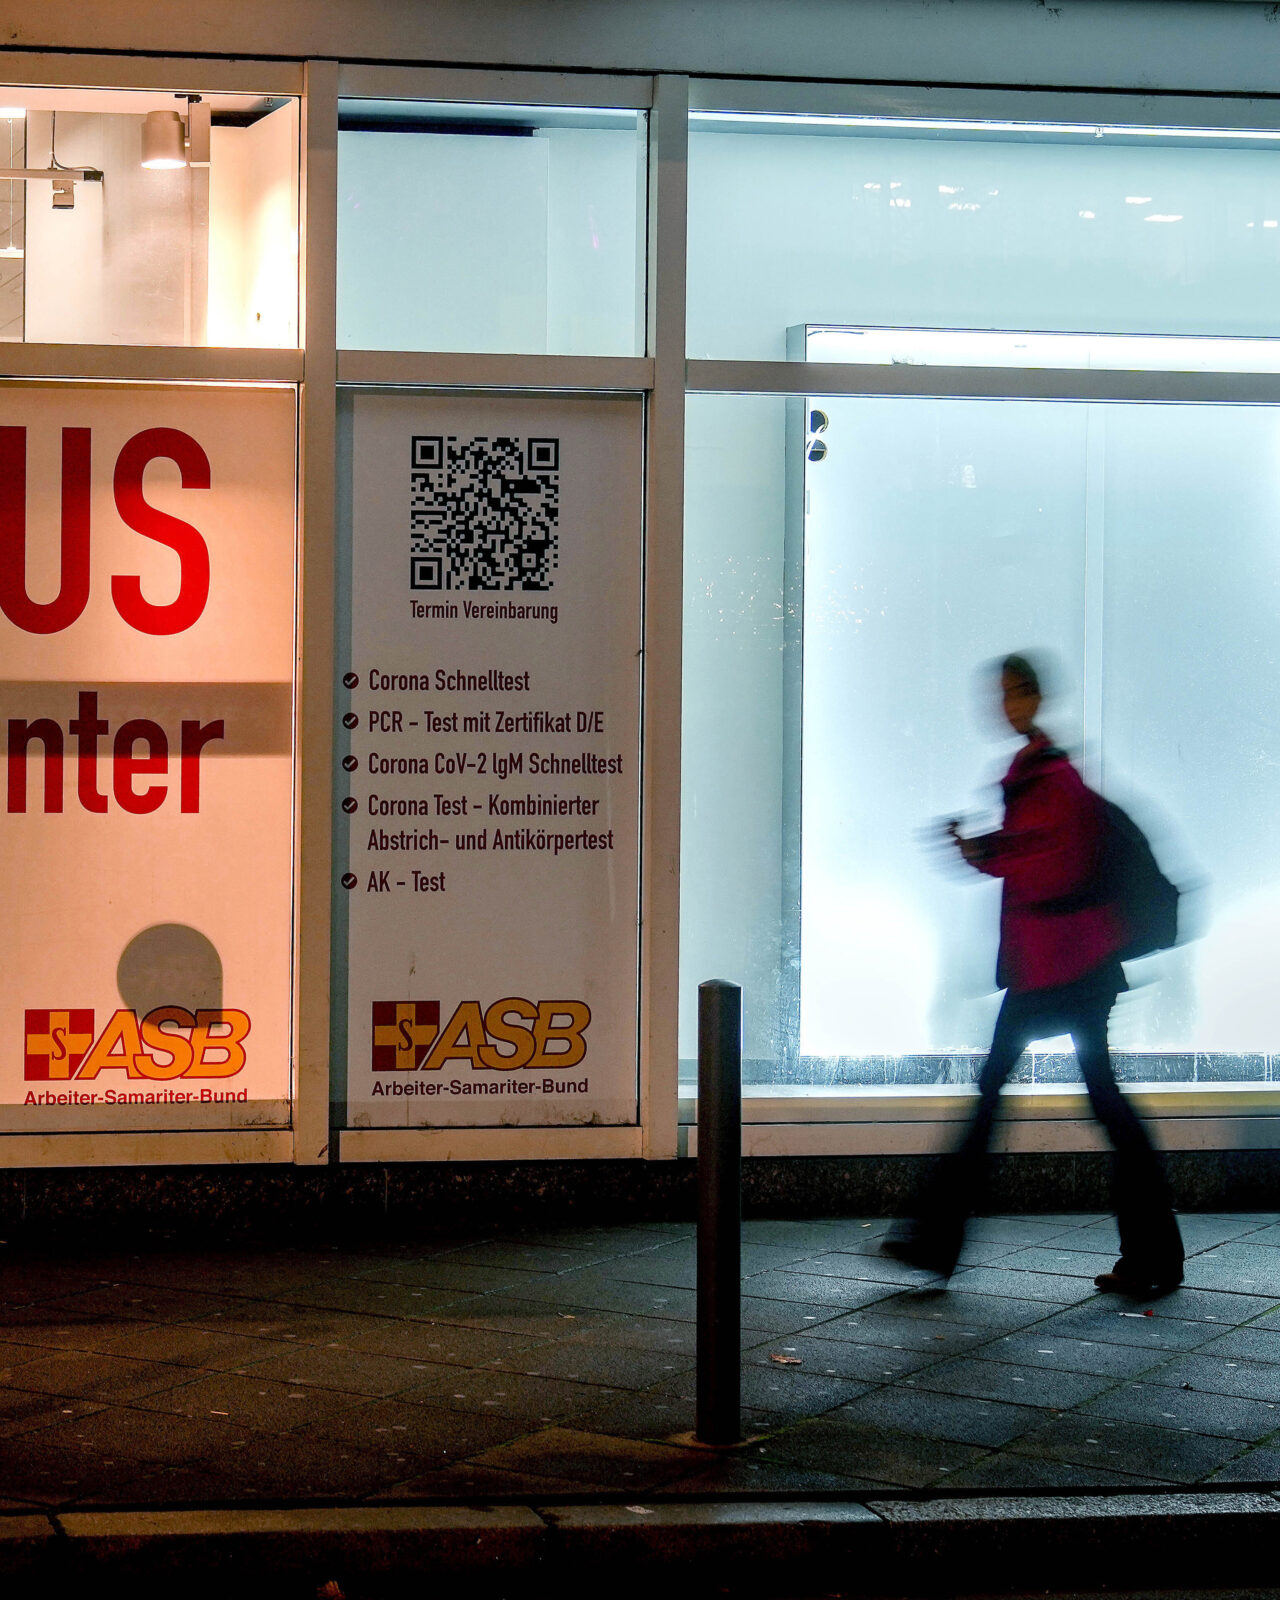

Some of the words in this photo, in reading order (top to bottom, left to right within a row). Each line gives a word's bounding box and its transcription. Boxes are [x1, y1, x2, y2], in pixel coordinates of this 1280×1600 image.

[410, 600, 458, 619] Termin
[463, 600, 558, 624] Vereinbarung
[369, 669, 430, 690] Corona
[435, 669, 530, 691] Schnelltest
[369, 711, 403, 733] PCR
[424, 710, 458, 733] Test
[464, 711, 491, 733] mit
[495, 711, 572, 733] Zertifikat
[577, 711, 604, 733] D/E
[369, 753, 429, 774] Corona
[529, 753, 623, 774] Schnelltest
[368, 794, 428, 816] Corona
[434, 794, 468, 816] Test
[489, 794, 600, 816] Kombinierter
[368, 829, 449, 851] Abstrich-
[456, 829, 487, 850] und
[493, 829, 614, 855] Antikörpertest
[367, 871, 391, 892] AK
[412, 871, 446, 892] Test
[78, 1006, 251, 1081] ASB
[421, 997, 592, 1071] ASB
[23, 1088, 248, 1105] Arbeiter-Samariter-Bund
[371, 1078, 589, 1096] Arbeiter-Samariter-Bund
